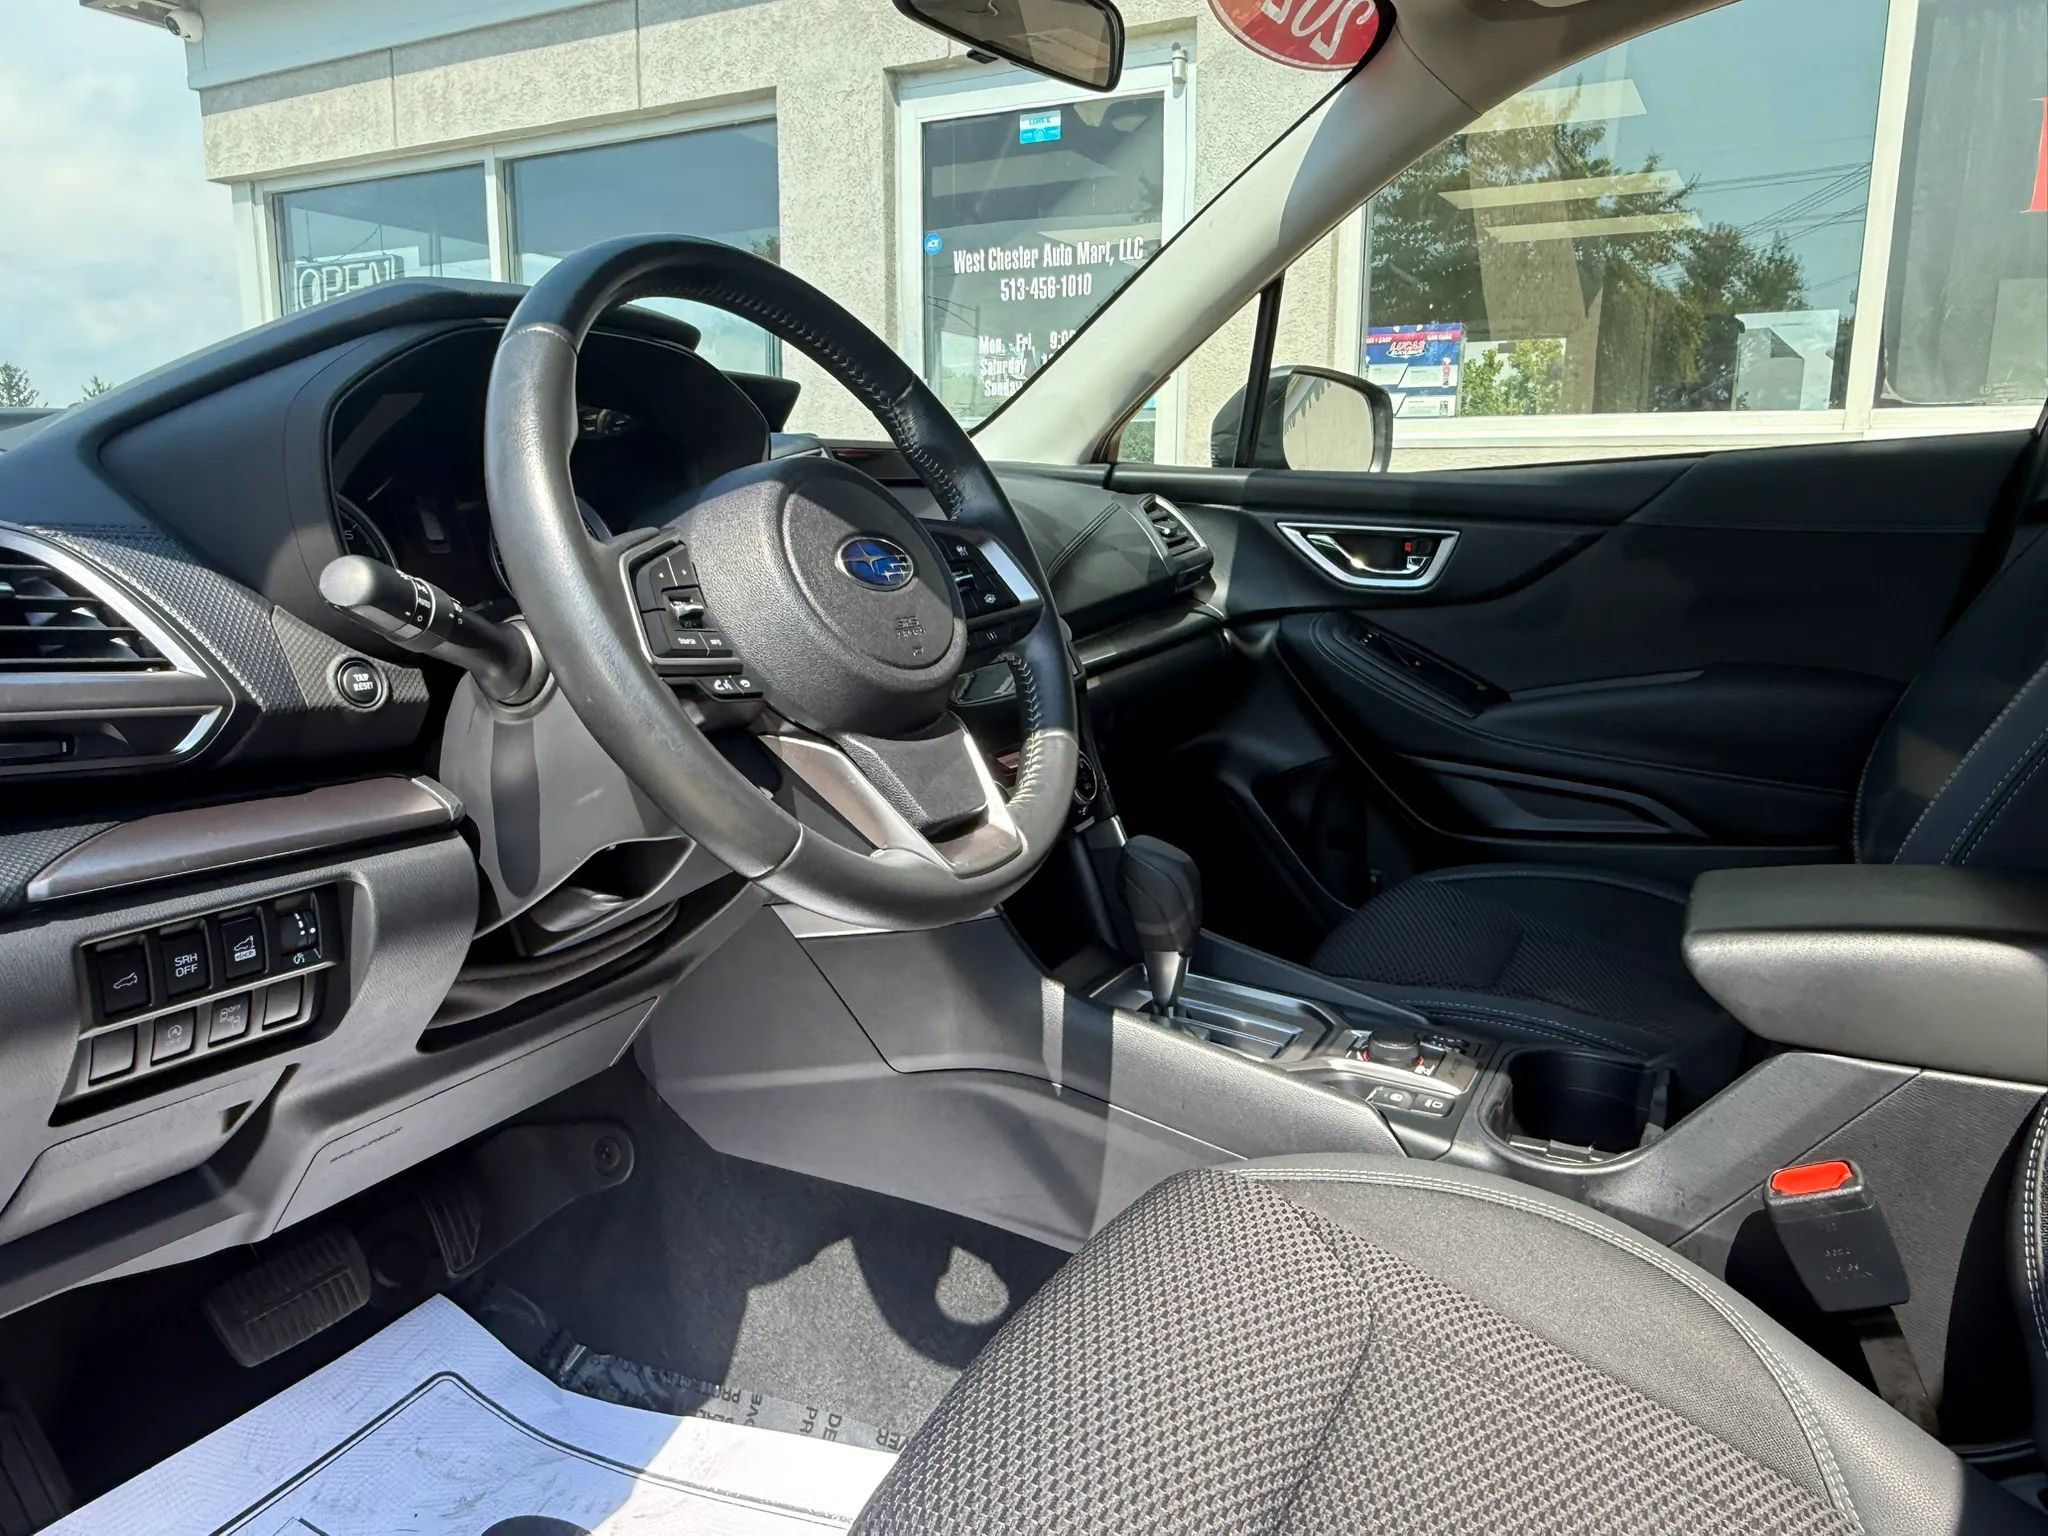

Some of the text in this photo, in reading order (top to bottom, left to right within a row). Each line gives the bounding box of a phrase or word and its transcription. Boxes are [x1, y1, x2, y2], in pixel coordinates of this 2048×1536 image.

[953, 236, 1144, 274] West Chester Auto Mart, LLC
[980, 355, 1027, 377] Saturday
[174, 953, 198, 967] SRH
[175, 963, 198, 978] OFF
